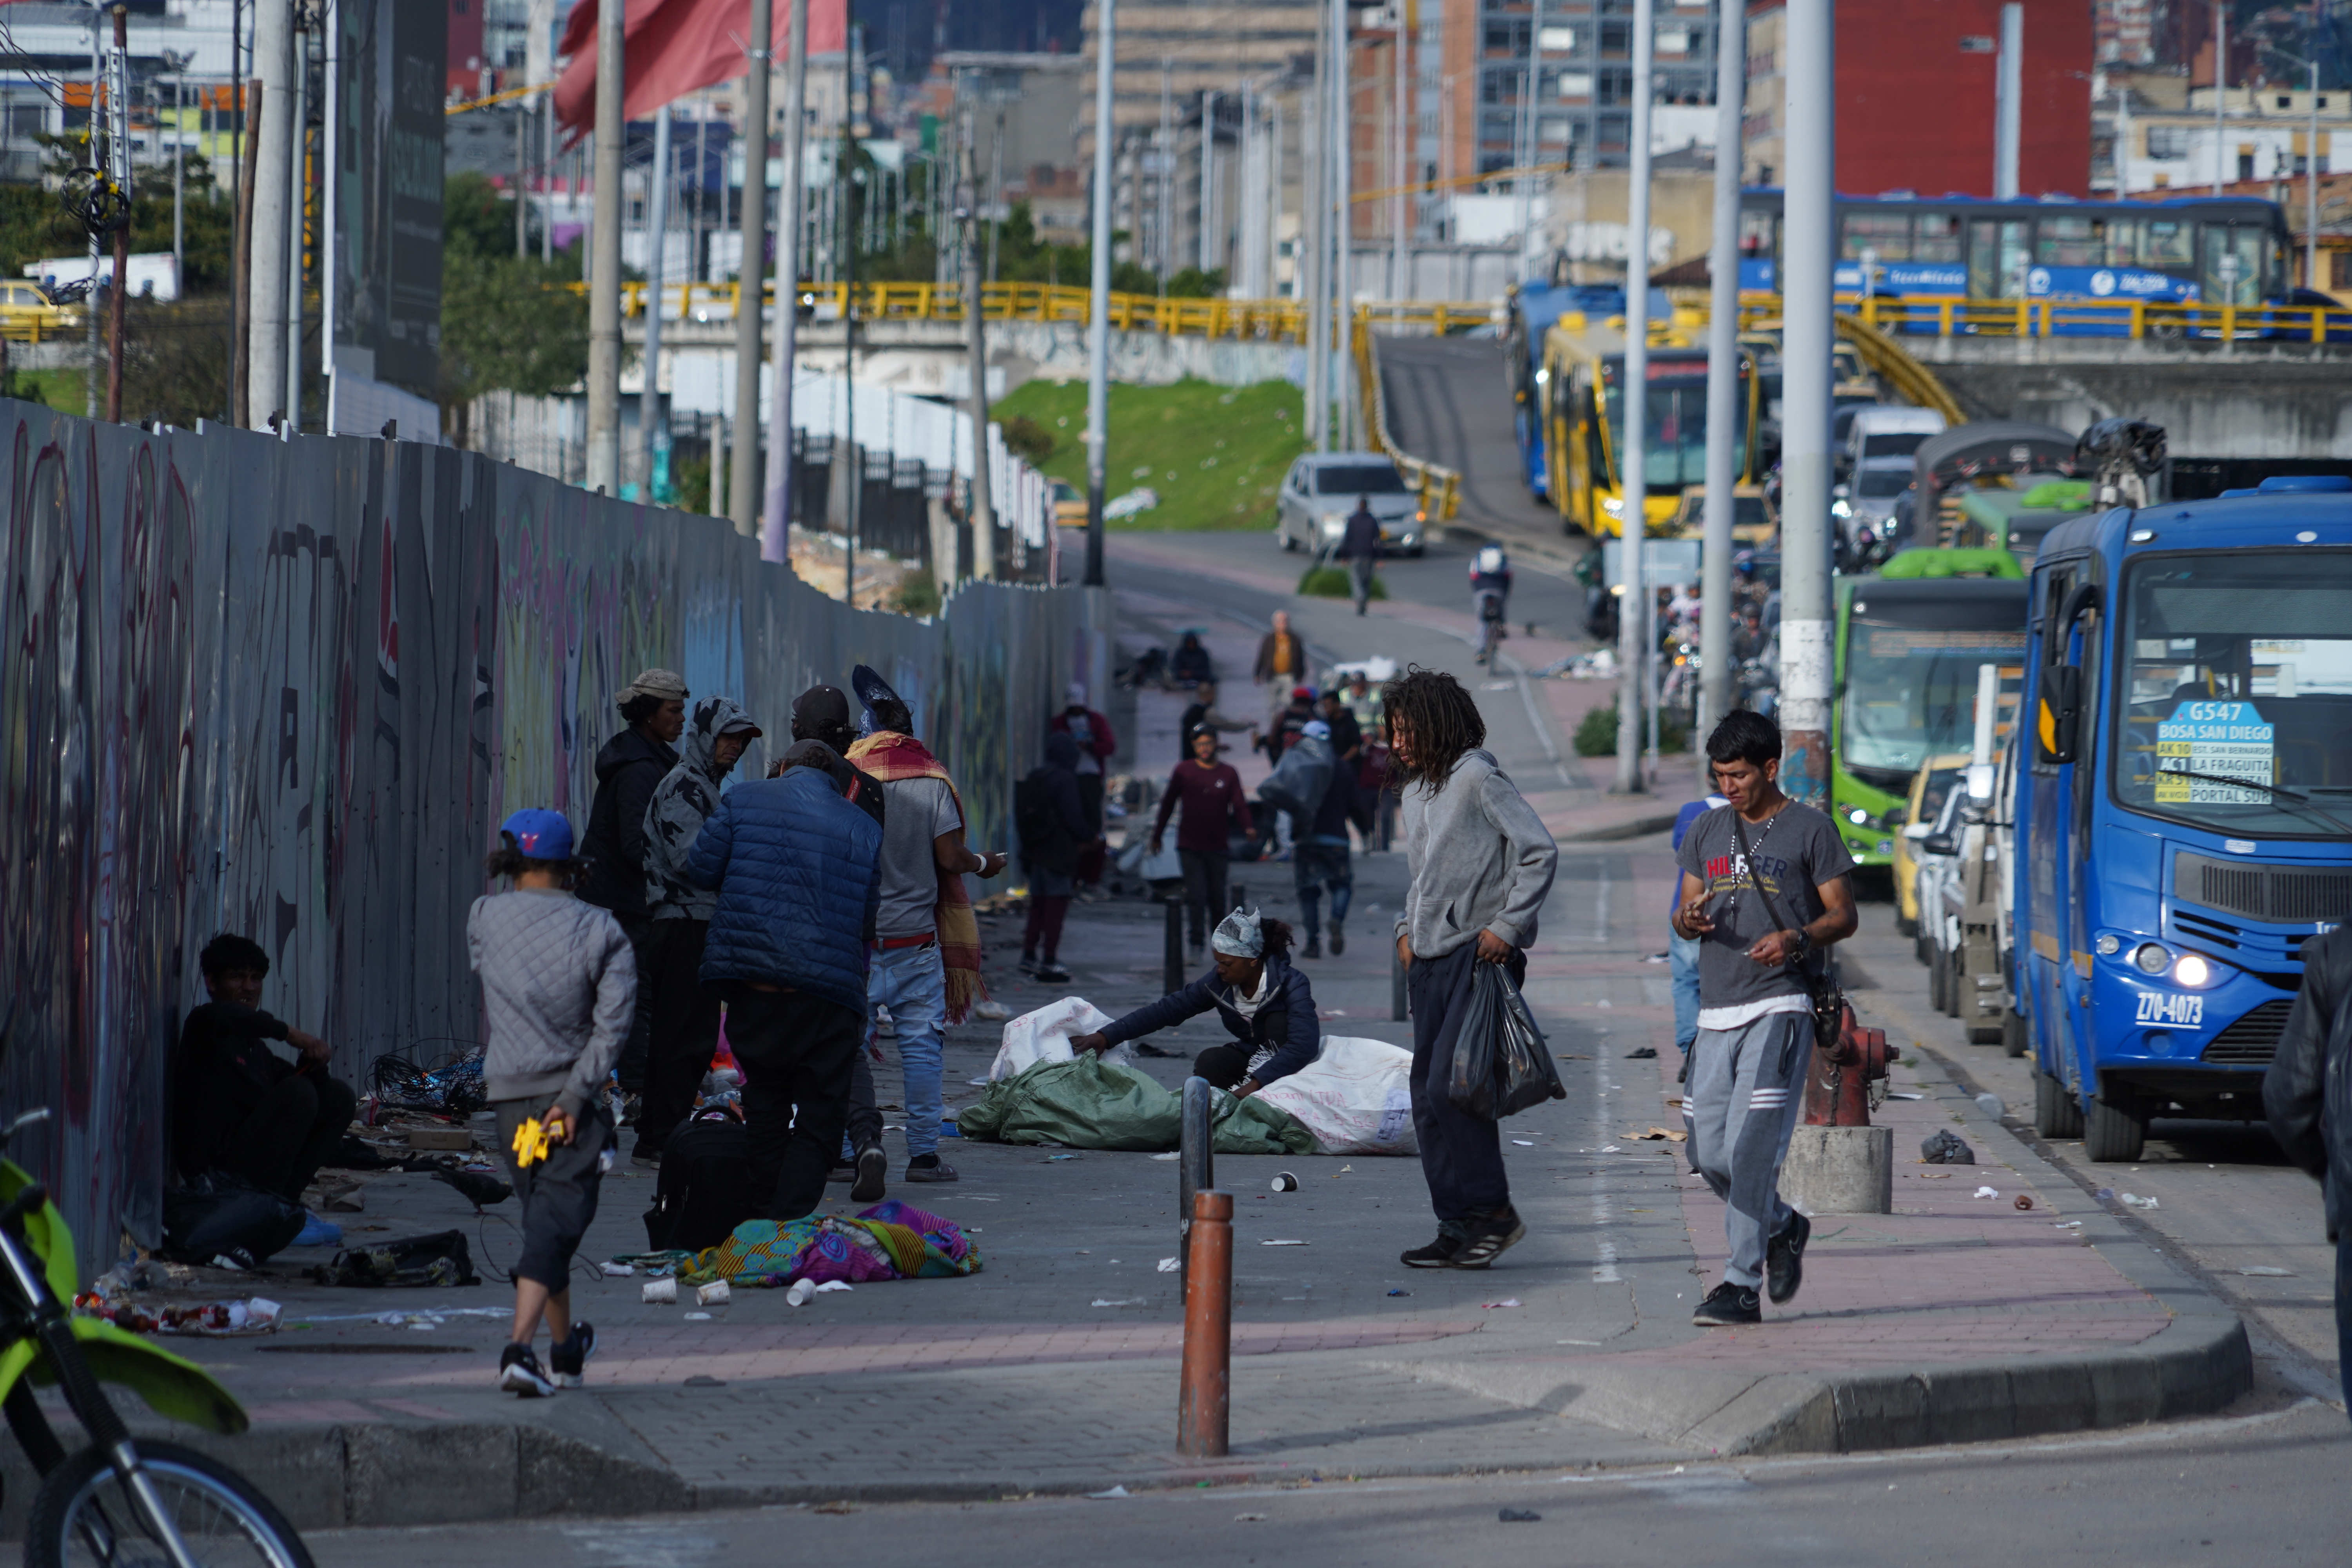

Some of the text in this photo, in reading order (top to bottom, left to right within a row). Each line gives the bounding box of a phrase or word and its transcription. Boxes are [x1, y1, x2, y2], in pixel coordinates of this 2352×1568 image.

[2190, 702, 2242, 721] G547
[2159, 724, 2272, 740] BOSA SAN DIEGO
[2177, 744, 2190, 754] 10
[2228, 746, 2272, 755] BERNARDO
[2192, 759, 2271, 771] LA FRAGUITA
[2192, 789, 2270, 802] PORTAL SUR
[2136, 992, 2203, 1024] Z70-4073
